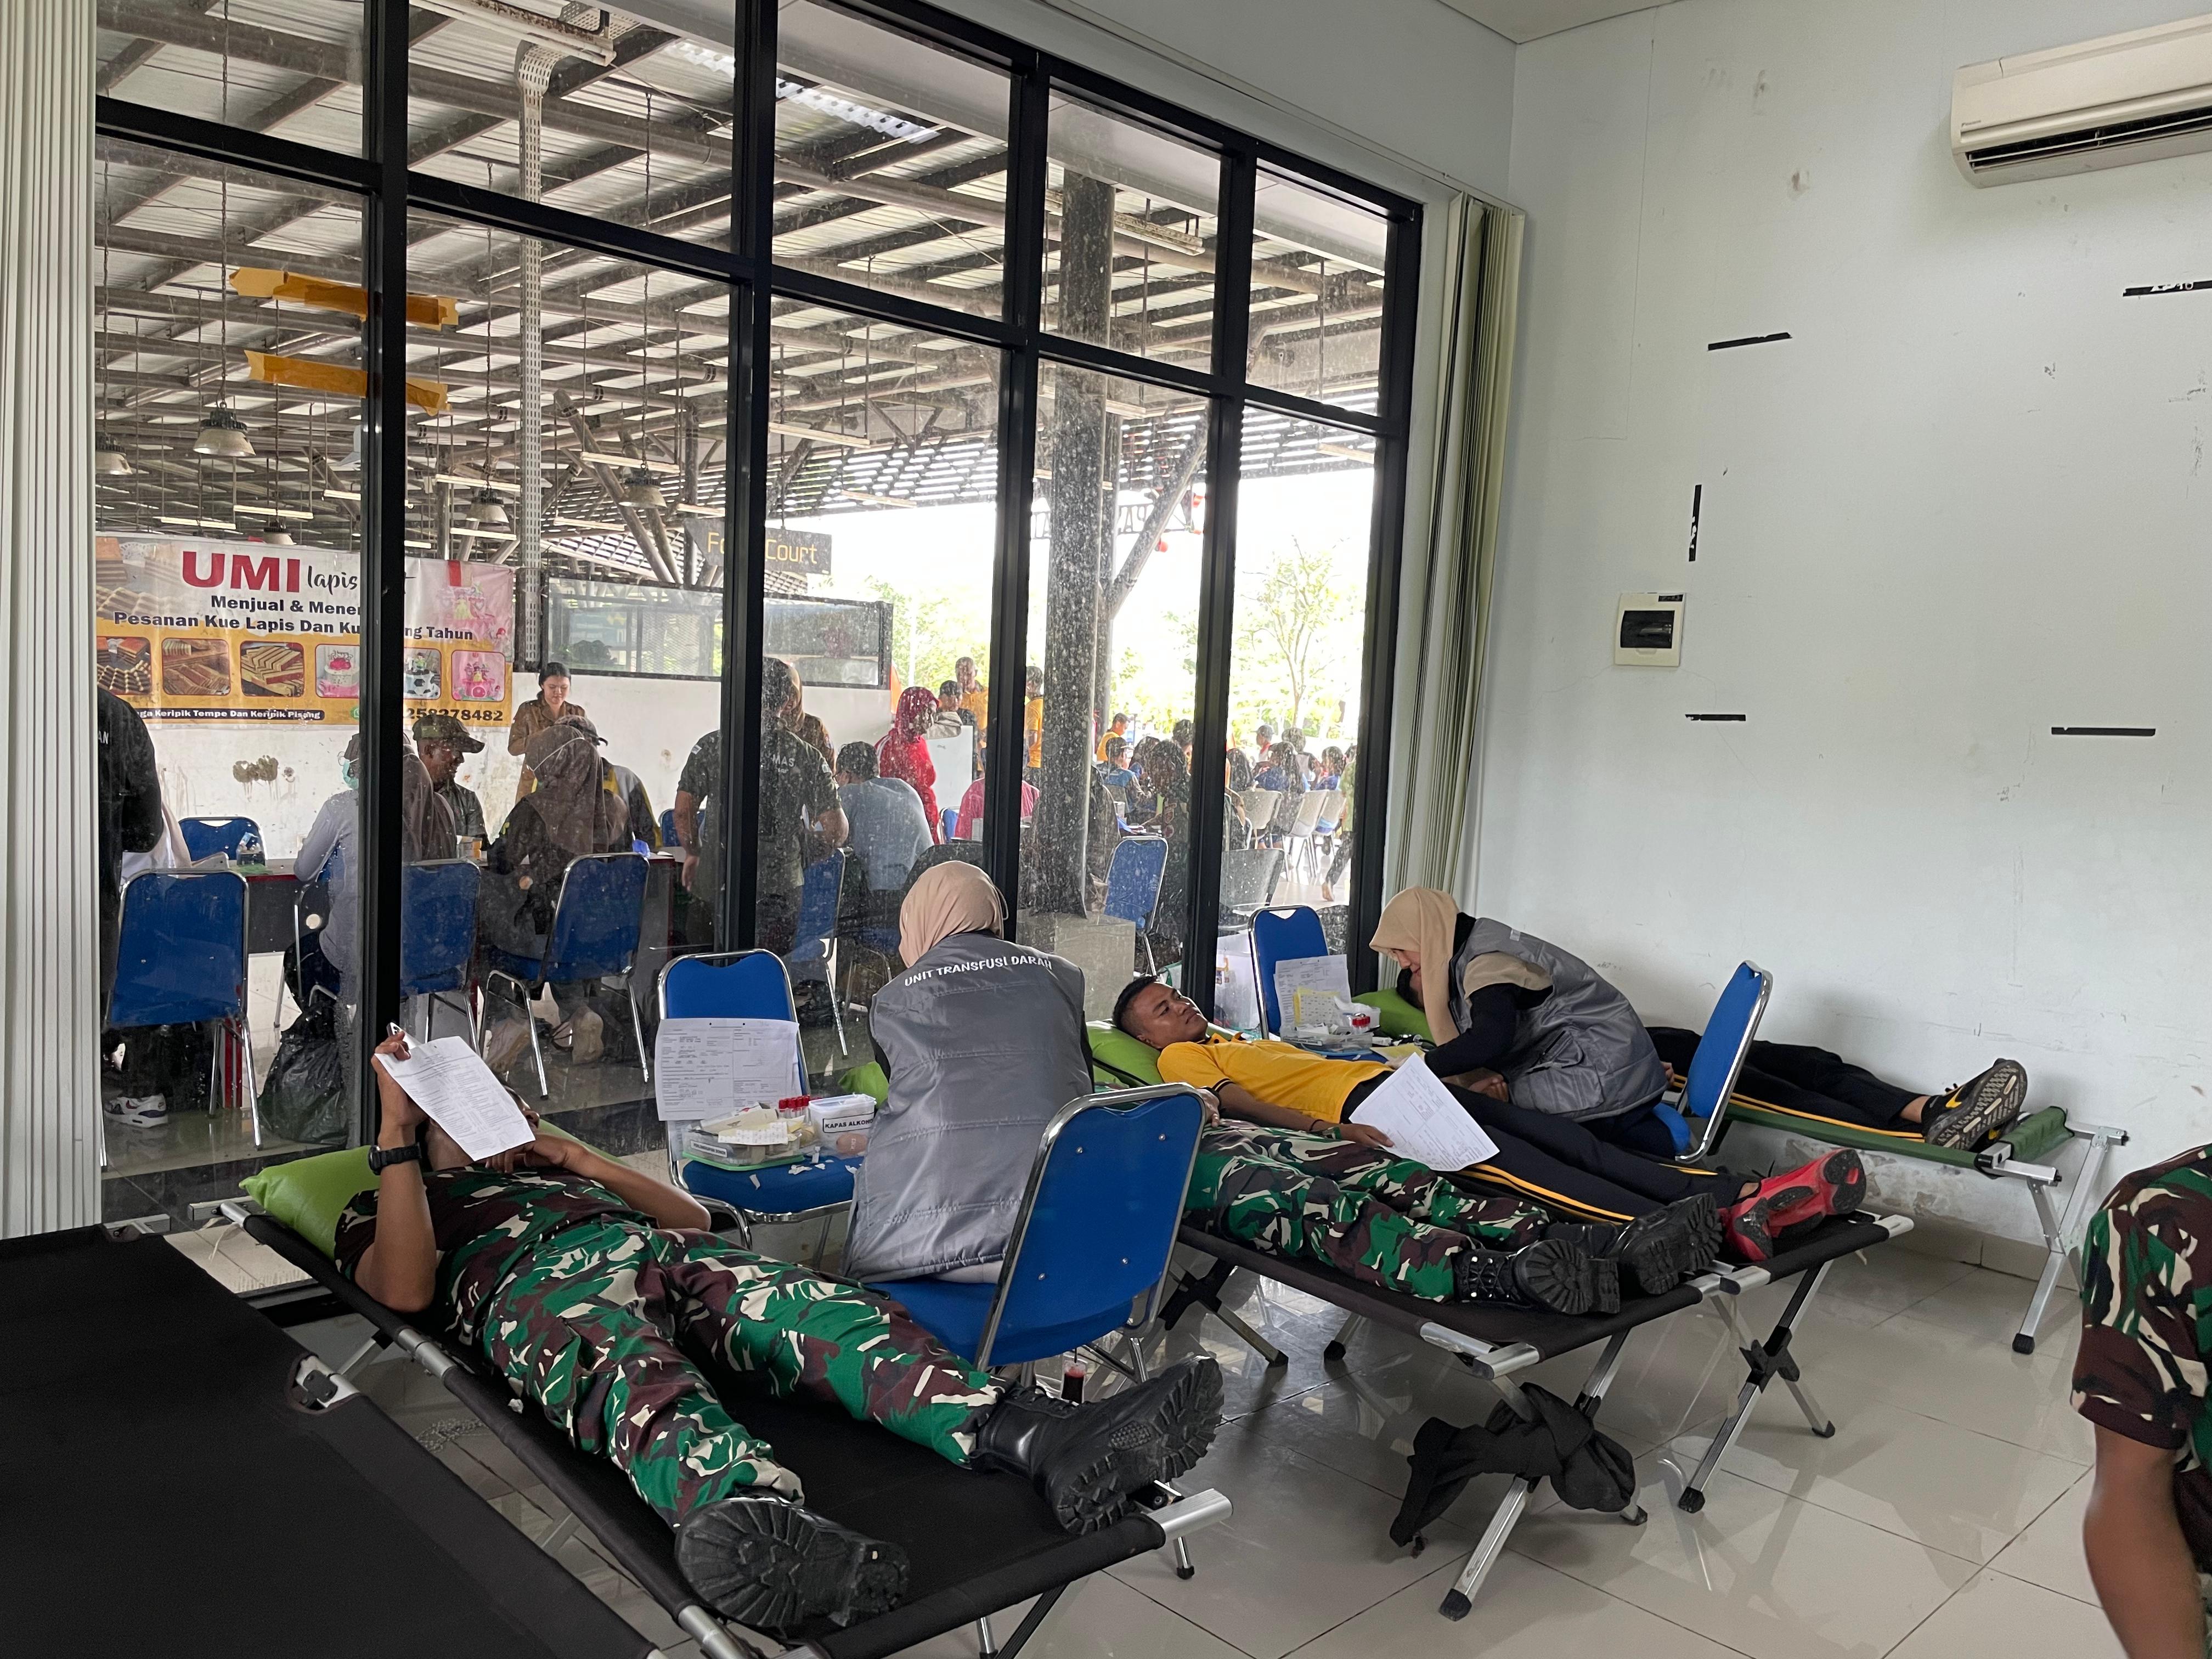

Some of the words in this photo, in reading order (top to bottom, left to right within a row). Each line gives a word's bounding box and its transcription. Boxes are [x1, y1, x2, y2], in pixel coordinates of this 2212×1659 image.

[765, 539, 817, 564] Court
[183, 551, 300, 592] UMI
[308, 566, 358, 595] lapis
[211, 595, 284, 612] Menjual
[290, 600, 303, 612] &
[309, 601, 360, 615] Mene
[114, 612, 199, 627] Pesanan
[205, 614, 240, 628] Kue
[246, 617, 295, 633] Lapis
[300, 620, 334, 633] Dan
[340, 622, 360, 634] Ku
[426, 627, 473, 640] Tahun
[155, 709, 191, 718] Keripik
[287, 711, 320, 719] Pisang
[905, 969, 934, 986] UNIT
[936, 956, 1008, 975] TRANSFUSI
[1011, 955, 1052, 970] DARAH
